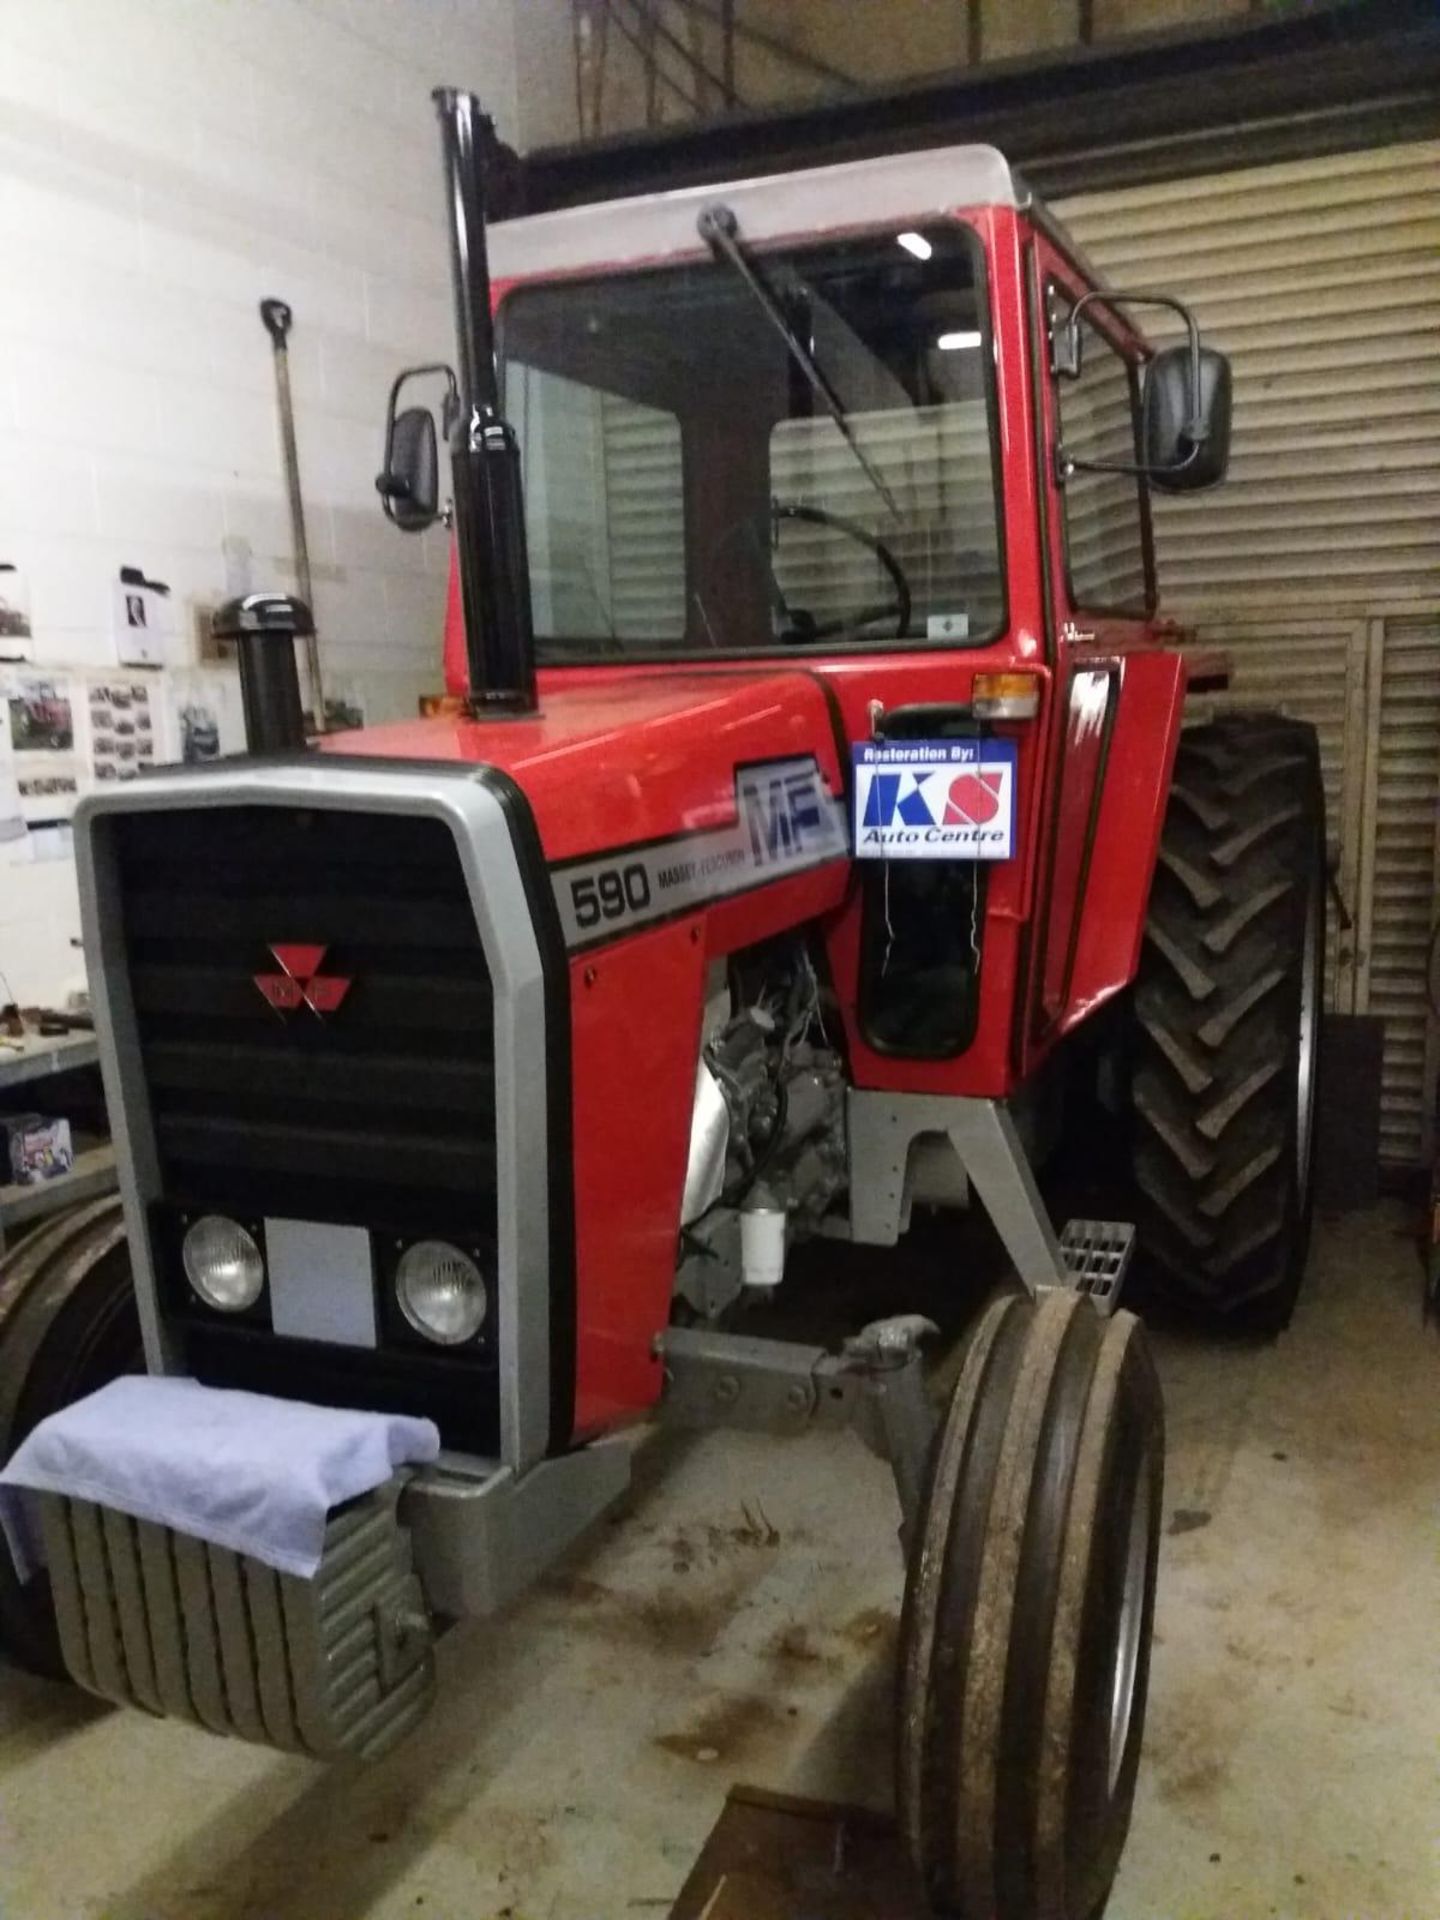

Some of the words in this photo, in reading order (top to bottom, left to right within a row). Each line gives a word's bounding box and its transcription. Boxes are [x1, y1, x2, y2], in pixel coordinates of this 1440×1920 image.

[864, 747, 946, 762] Restoration
[950, 746, 974, 762] By:
[863, 771, 1003, 826] KS
[864, 829, 919, 843] Auto
[924, 828, 1004, 842] Centre
[570, 863, 650, 929] 590
